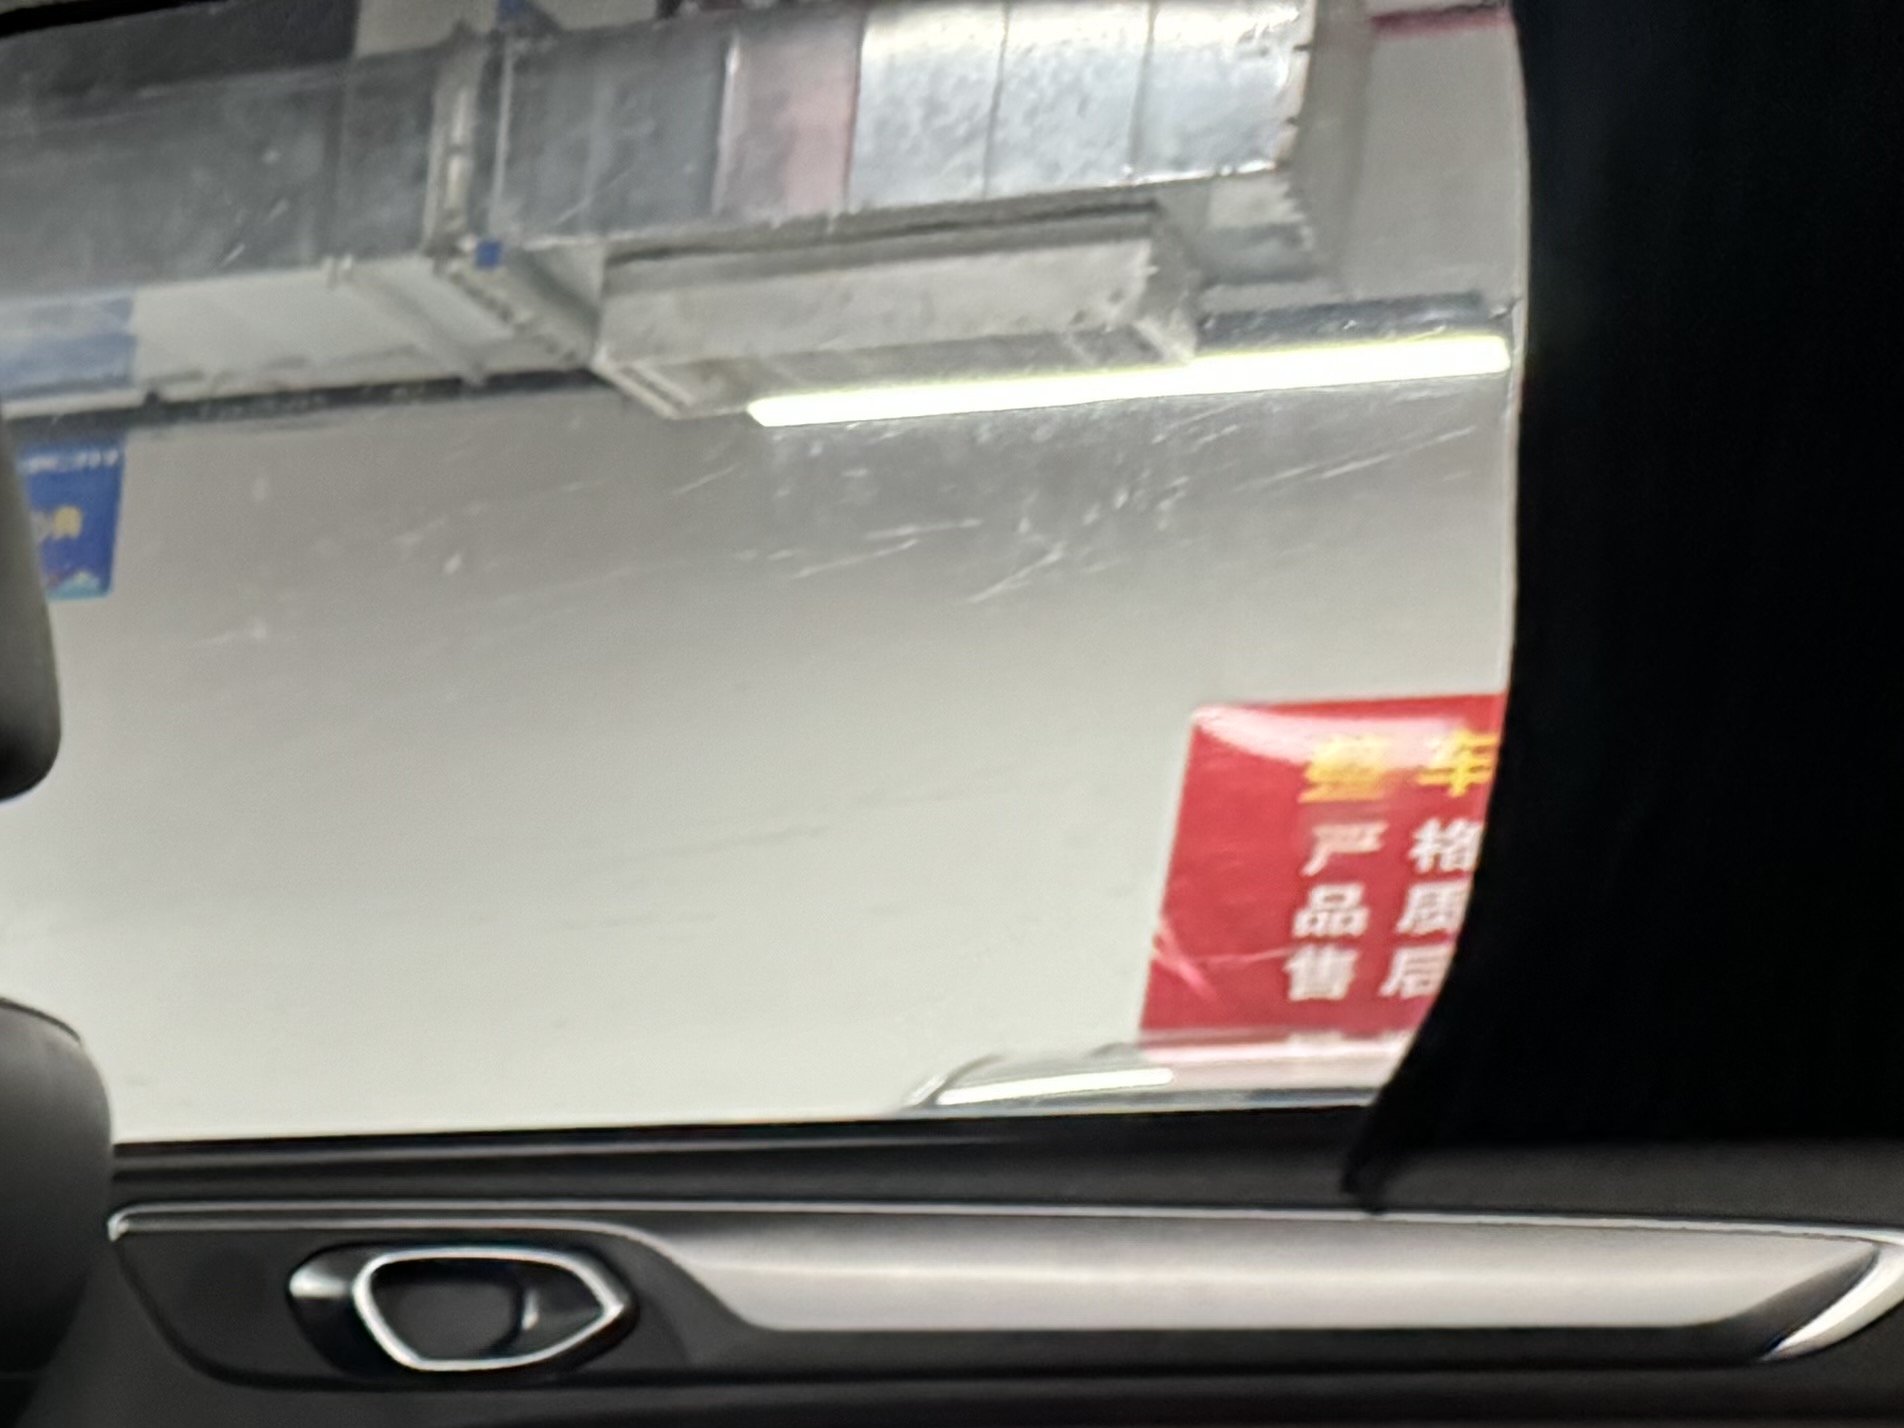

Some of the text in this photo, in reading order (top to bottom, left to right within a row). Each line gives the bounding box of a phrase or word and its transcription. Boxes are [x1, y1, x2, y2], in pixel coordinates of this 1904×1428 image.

[1300, 817, 1484, 876] 严格
[1293, 882, 1471, 938] 品质
[1283, 943, 1454, 1001] 售后
